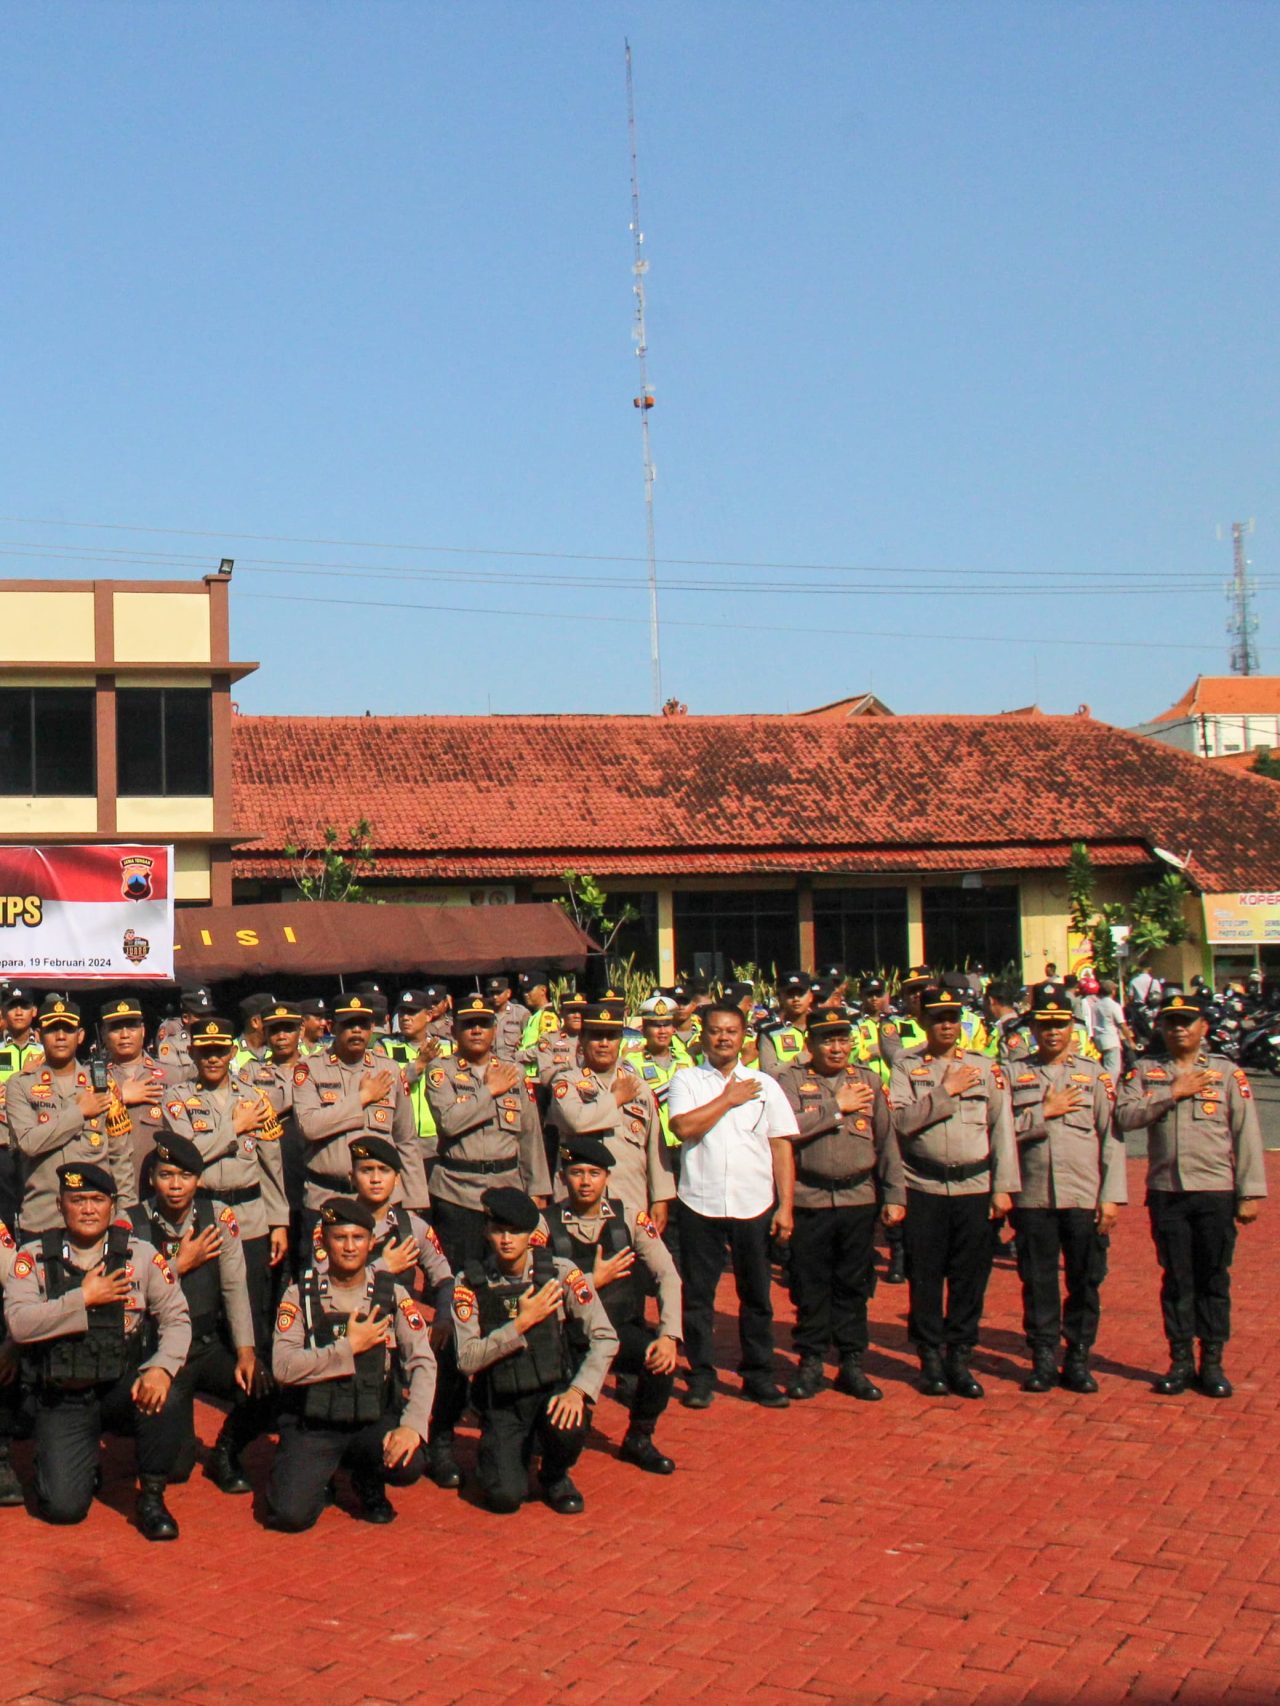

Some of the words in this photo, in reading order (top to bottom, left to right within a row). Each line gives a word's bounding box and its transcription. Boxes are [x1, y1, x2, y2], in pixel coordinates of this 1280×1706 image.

[30, 957, 41, 967] 19
[43, 957, 85, 967] Februari
[88, 958, 112, 967] 2024
